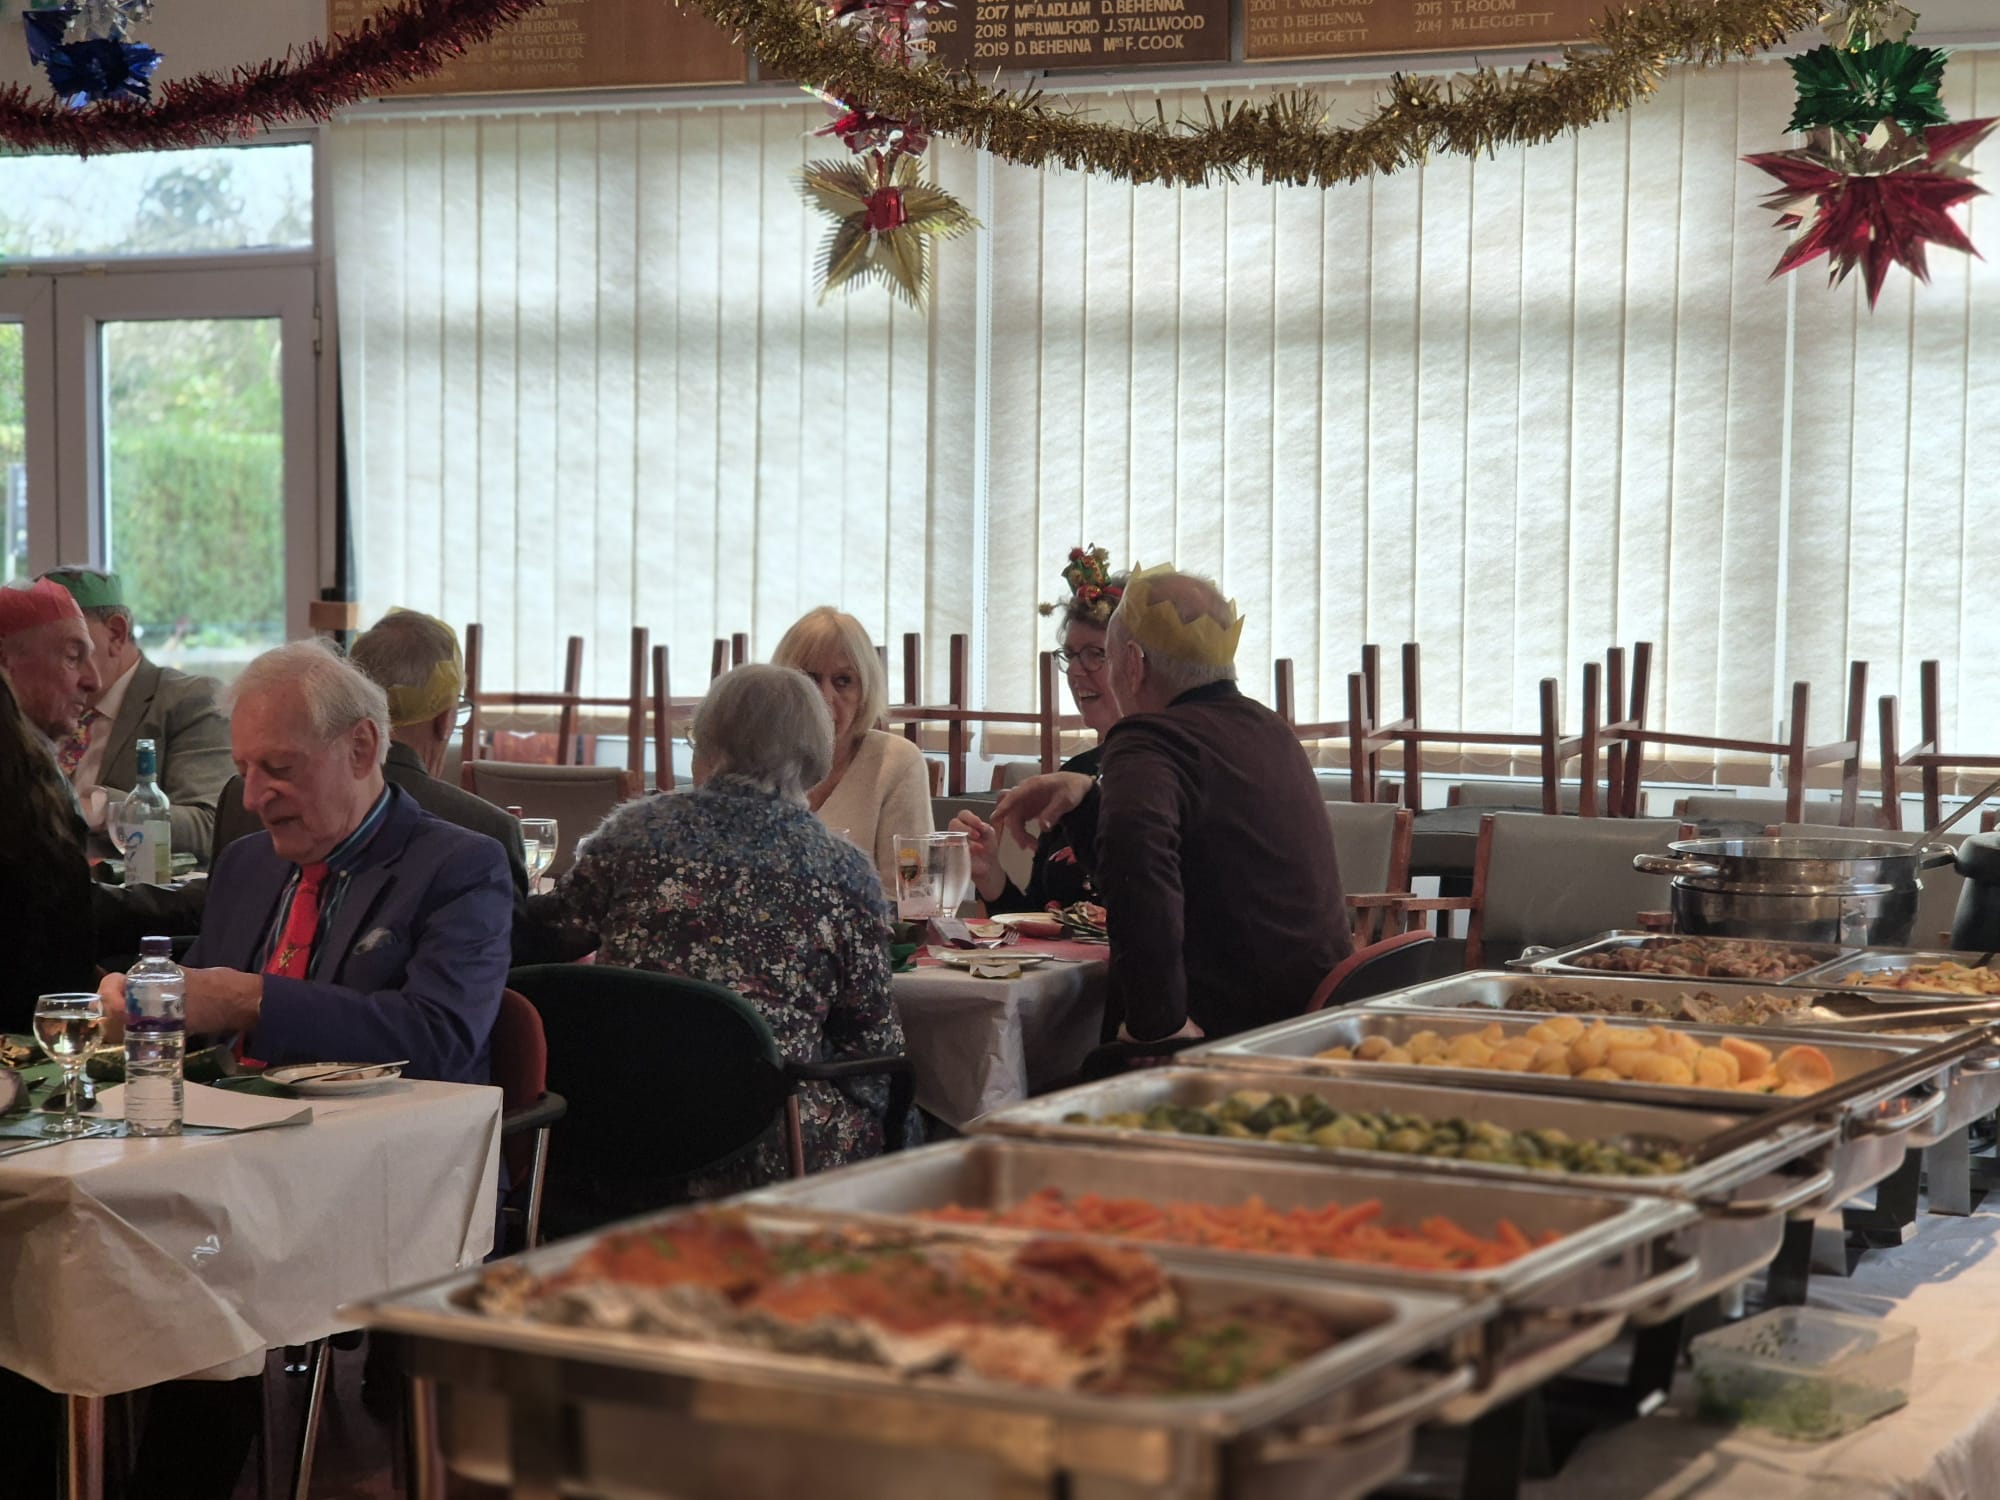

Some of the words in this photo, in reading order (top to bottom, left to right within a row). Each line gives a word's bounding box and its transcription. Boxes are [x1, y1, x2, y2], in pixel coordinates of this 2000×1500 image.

[976, 5, 1010, 21] 2017
[1116, 0, 1185, 14] BEHENNA
[975, 24, 1007, 39] 2018
[974, 42, 1010, 58] 2019
[1029, 38, 1092, 55] BEHENNA
